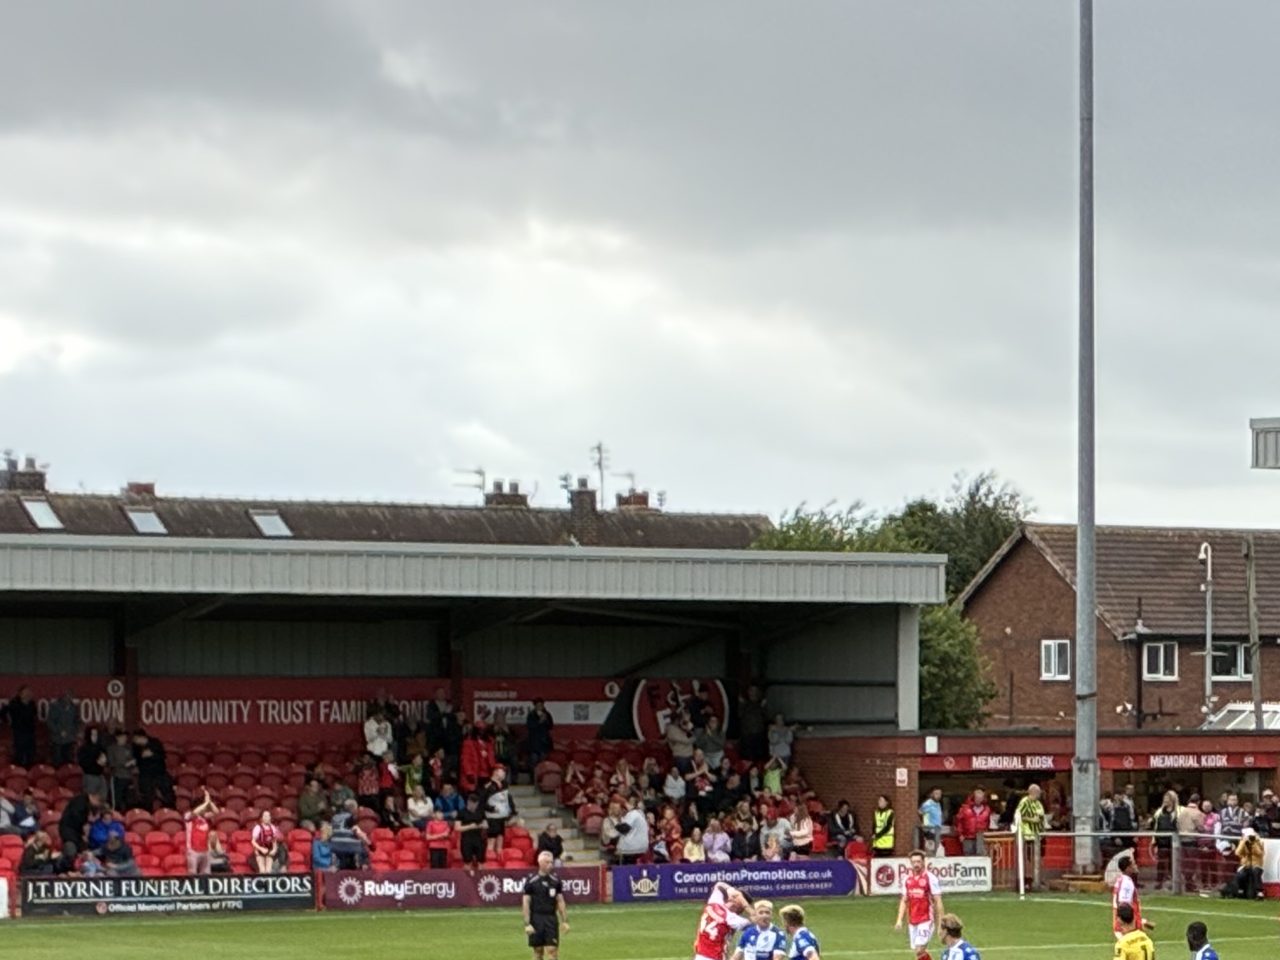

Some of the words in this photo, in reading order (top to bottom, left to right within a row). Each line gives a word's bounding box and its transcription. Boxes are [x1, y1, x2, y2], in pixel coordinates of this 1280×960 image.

[141, 699, 250, 724] COMMUNITY
[257, 699, 314, 724] TRUST
[972, 756, 1023, 770] MEMORIAL
[1025, 755, 1054, 769] KIOSK
[1149, 755, 1199, 768] MEMORIAL
[674, 869, 833, 884] CoronationPromotions.co.uk
[27, 881, 51, 902] J.T.
[54, 880, 114, 898] BYRNE
[121, 878, 204, 897] FUNERAL
[207, 876, 312, 894] DIRECTORS
[364, 880, 455, 899] RubyEnergy
